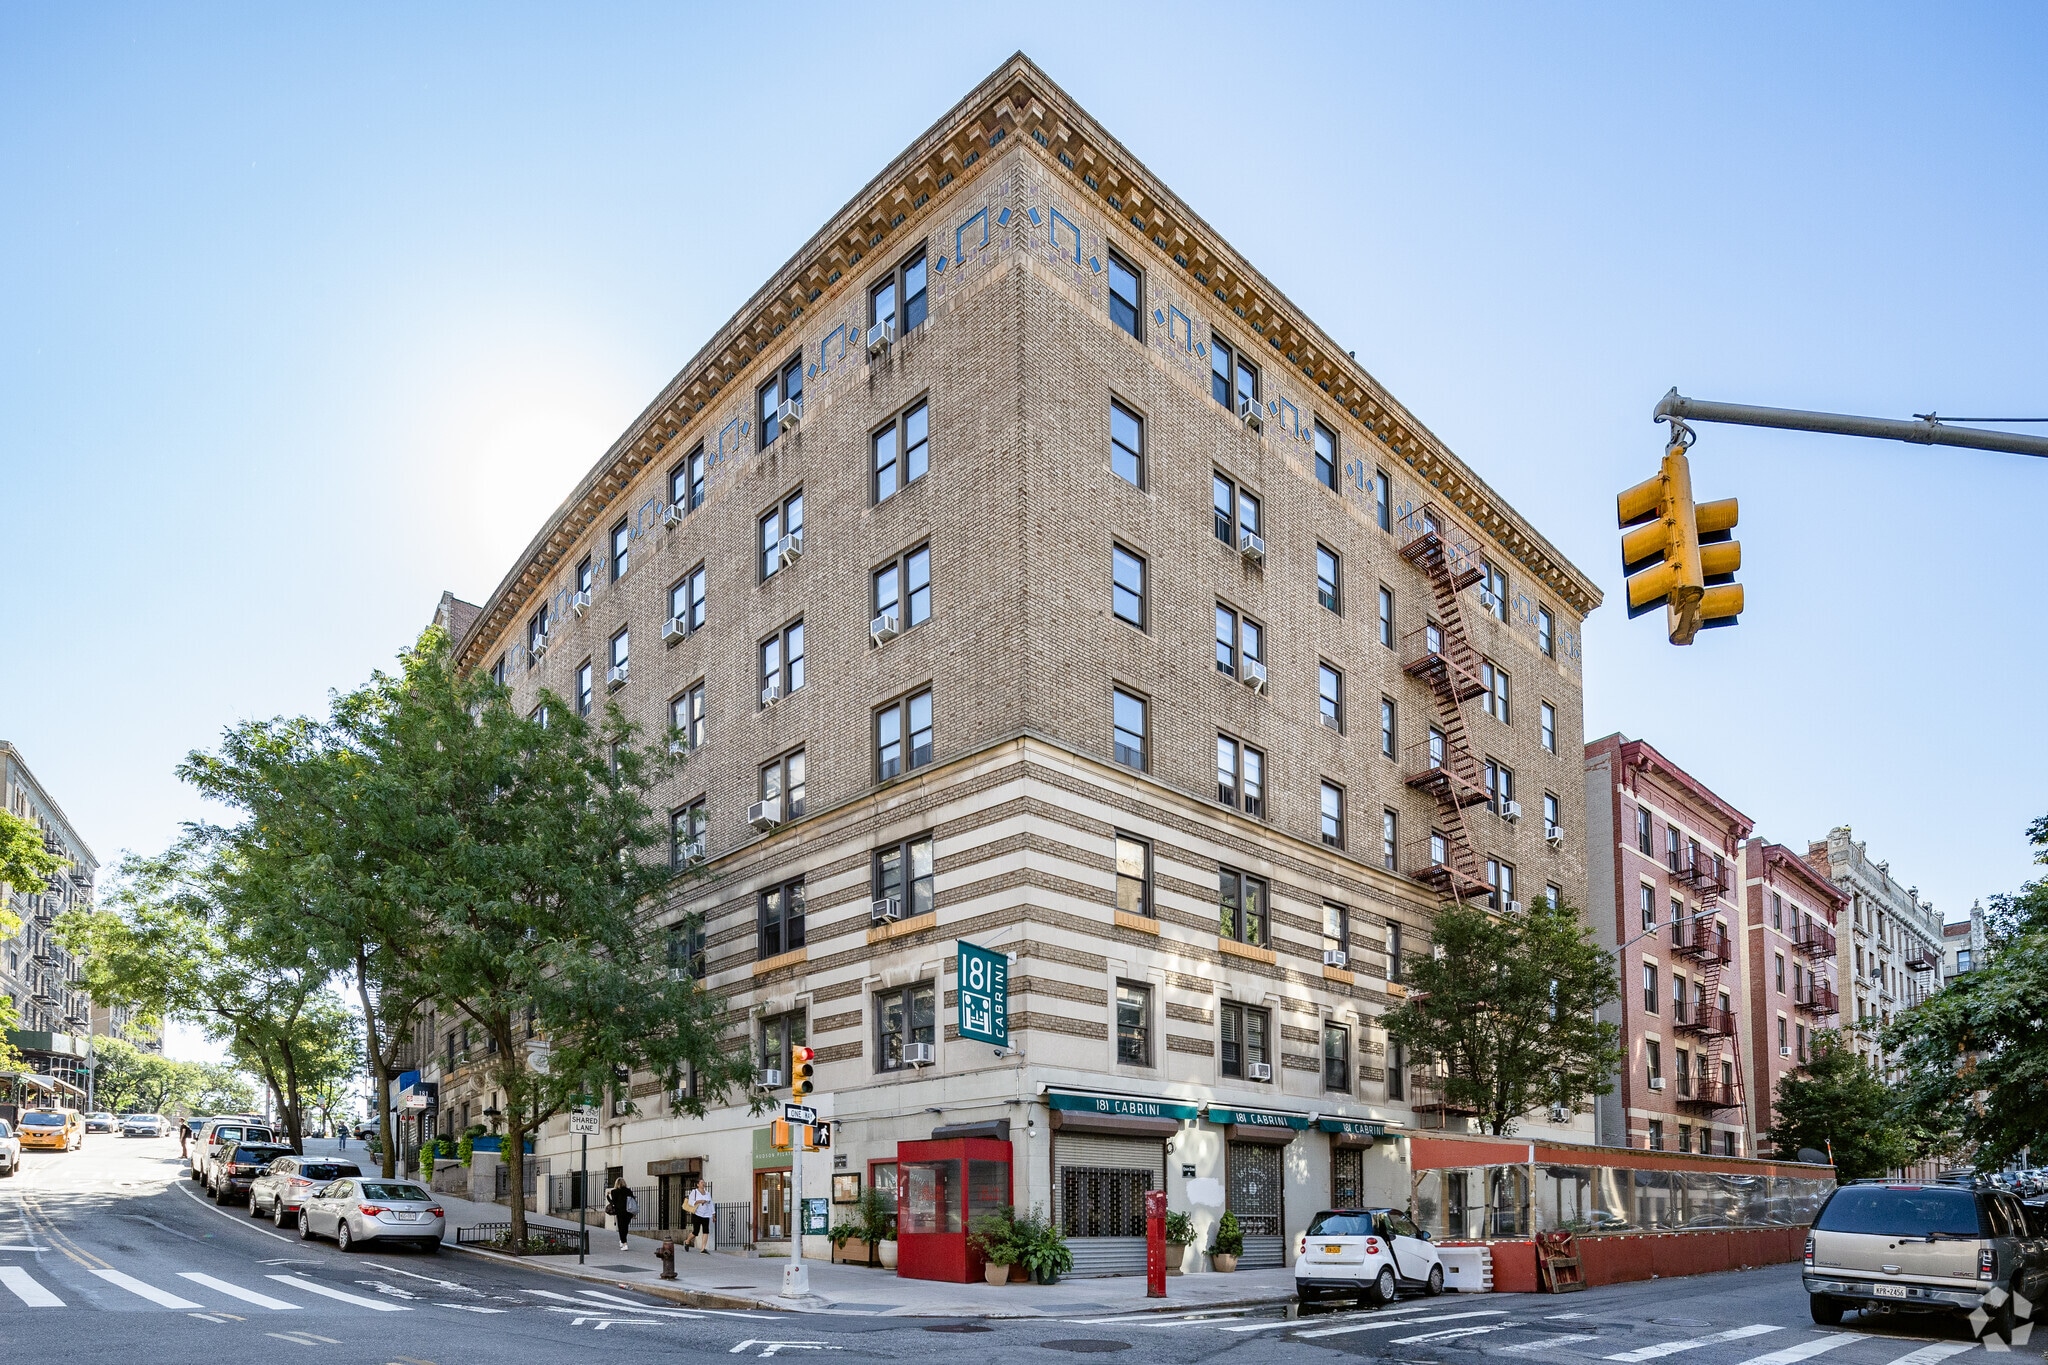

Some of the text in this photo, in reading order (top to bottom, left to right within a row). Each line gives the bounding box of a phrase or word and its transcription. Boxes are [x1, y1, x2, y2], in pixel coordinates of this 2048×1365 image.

[962, 953, 992, 993] 181
[994, 964, 1005, 1038] CABRINI
[790, 1109, 814, 1119] ONE WAY
[1096, 1099, 1160, 1116] 181 CABRINI
[571, 1116, 598, 1125] SHARED
[1235, 1112, 1288, 1126] 181 CABRINI
[575, 1124, 594, 1132] LANE
[1342, 1122, 1384, 1136] 181 CABRINI
